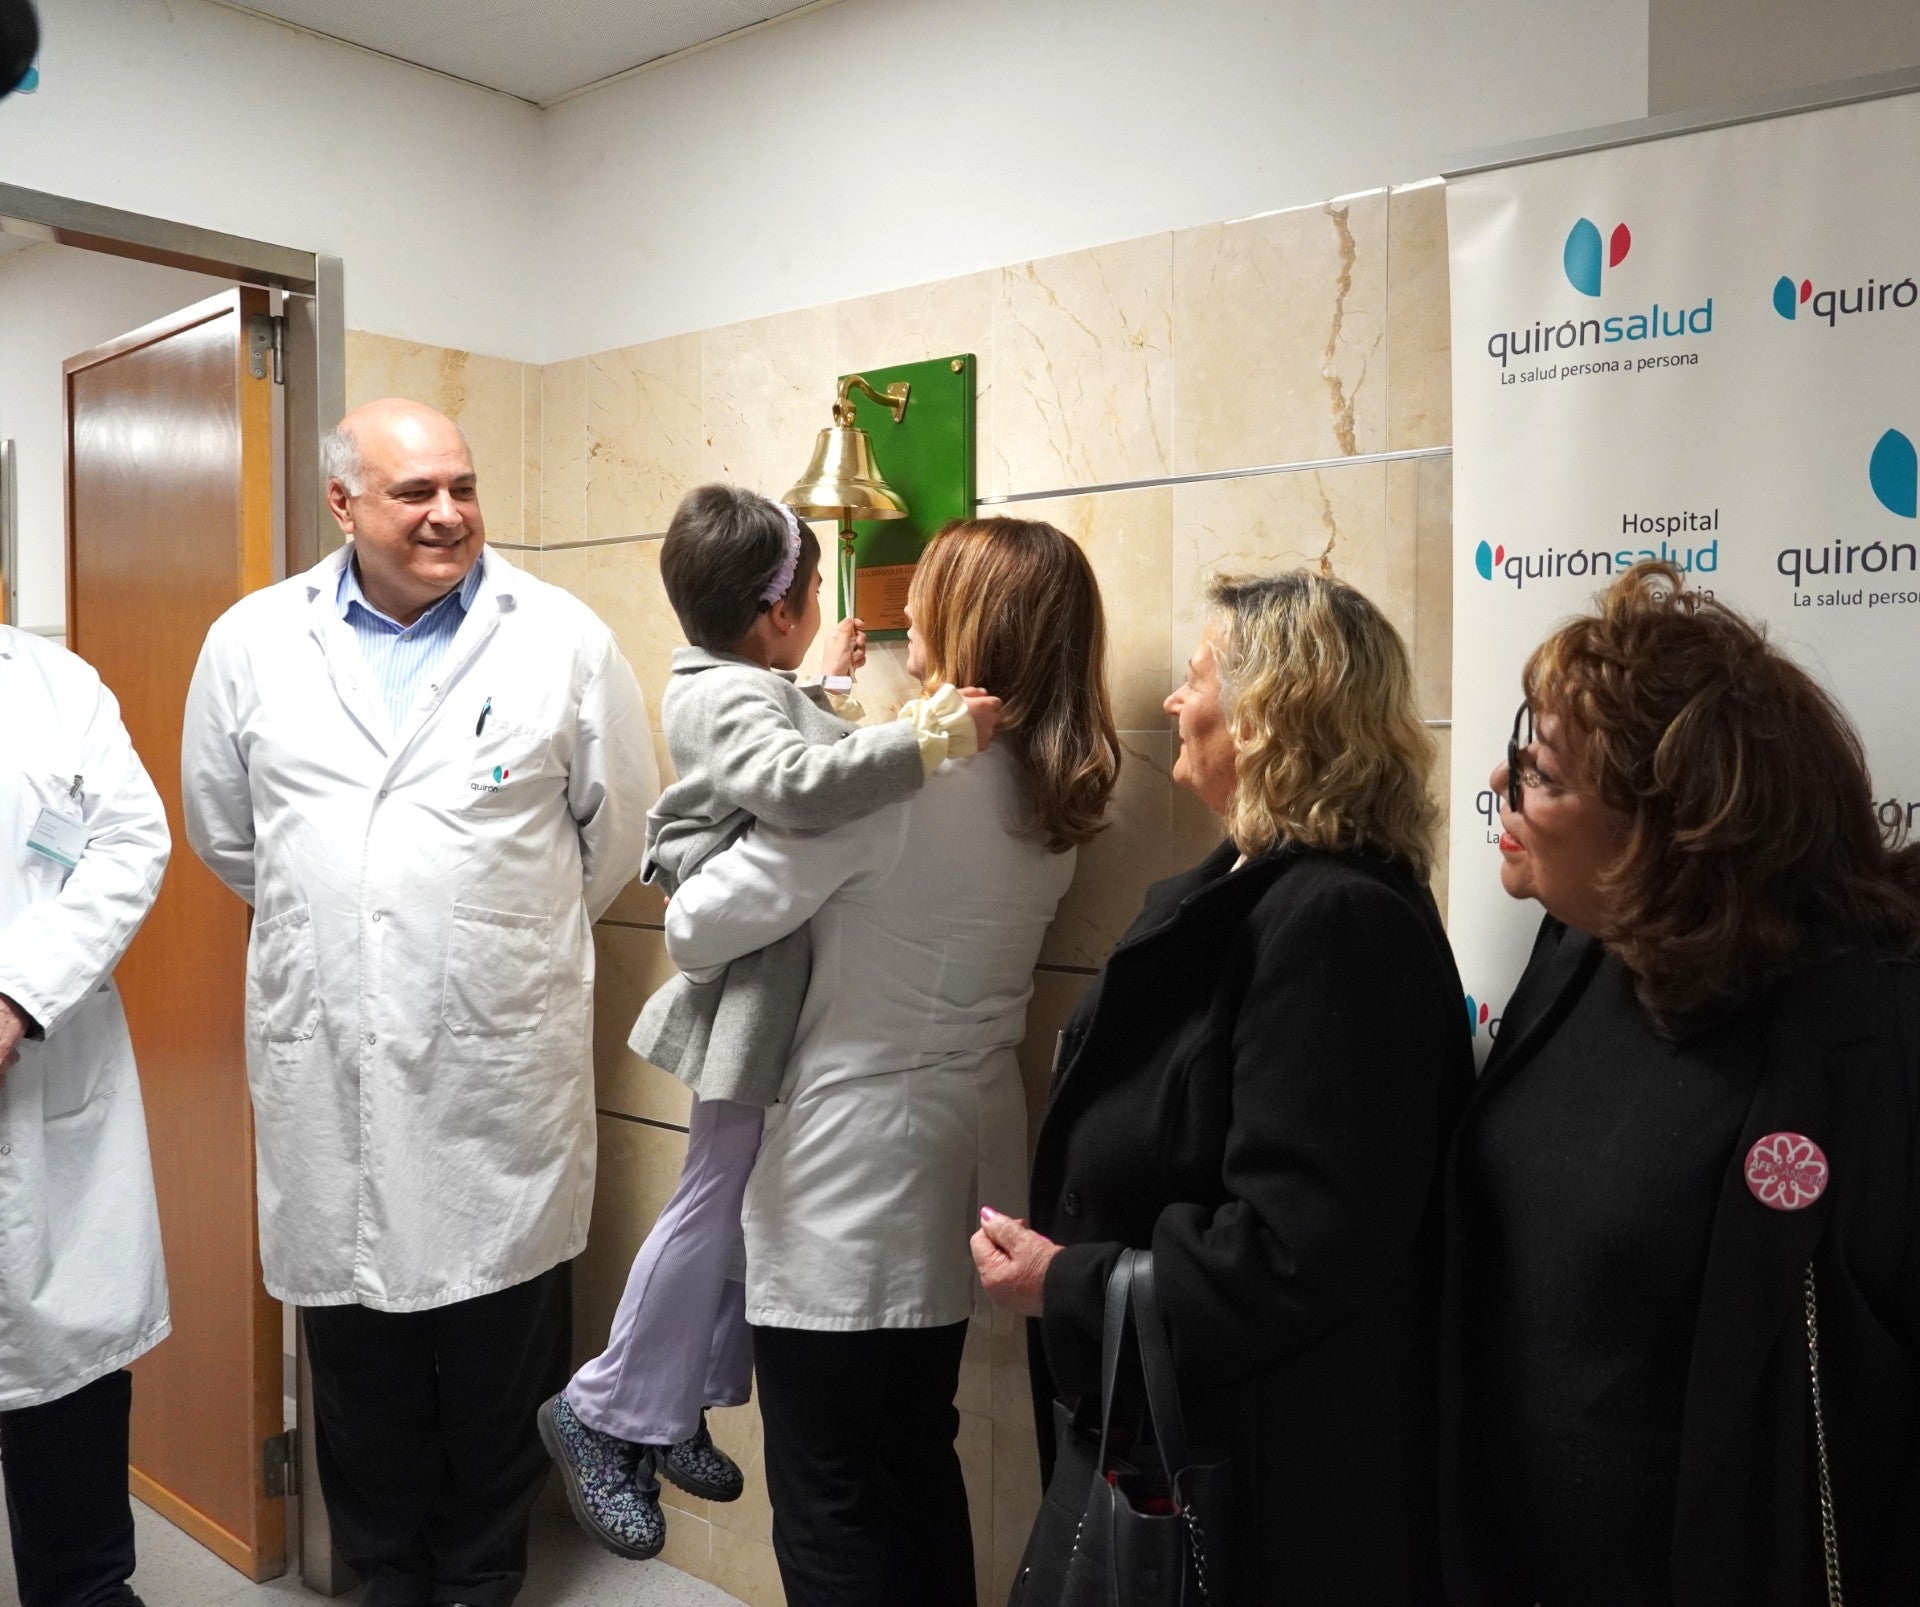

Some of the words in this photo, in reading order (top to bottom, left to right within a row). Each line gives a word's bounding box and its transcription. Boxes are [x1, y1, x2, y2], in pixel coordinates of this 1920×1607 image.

[1488, 298, 1713, 367] quirónsalud
[1501, 372, 1516, 385] La
[1520, 365, 1557, 383] salud
[1561, 359, 1619, 380] persona
[1624, 359, 1632, 370] a
[1637, 353, 1698, 373] persona
[1623, 508, 1719, 537] Hospital
[1777, 539, 1917, 587] quirón
[1794, 592, 1811, 606] La
[1817, 589, 1862, 606] salud
[1869, 591, 1920, 608] perso
[1487, 830, 1499, 843] La
